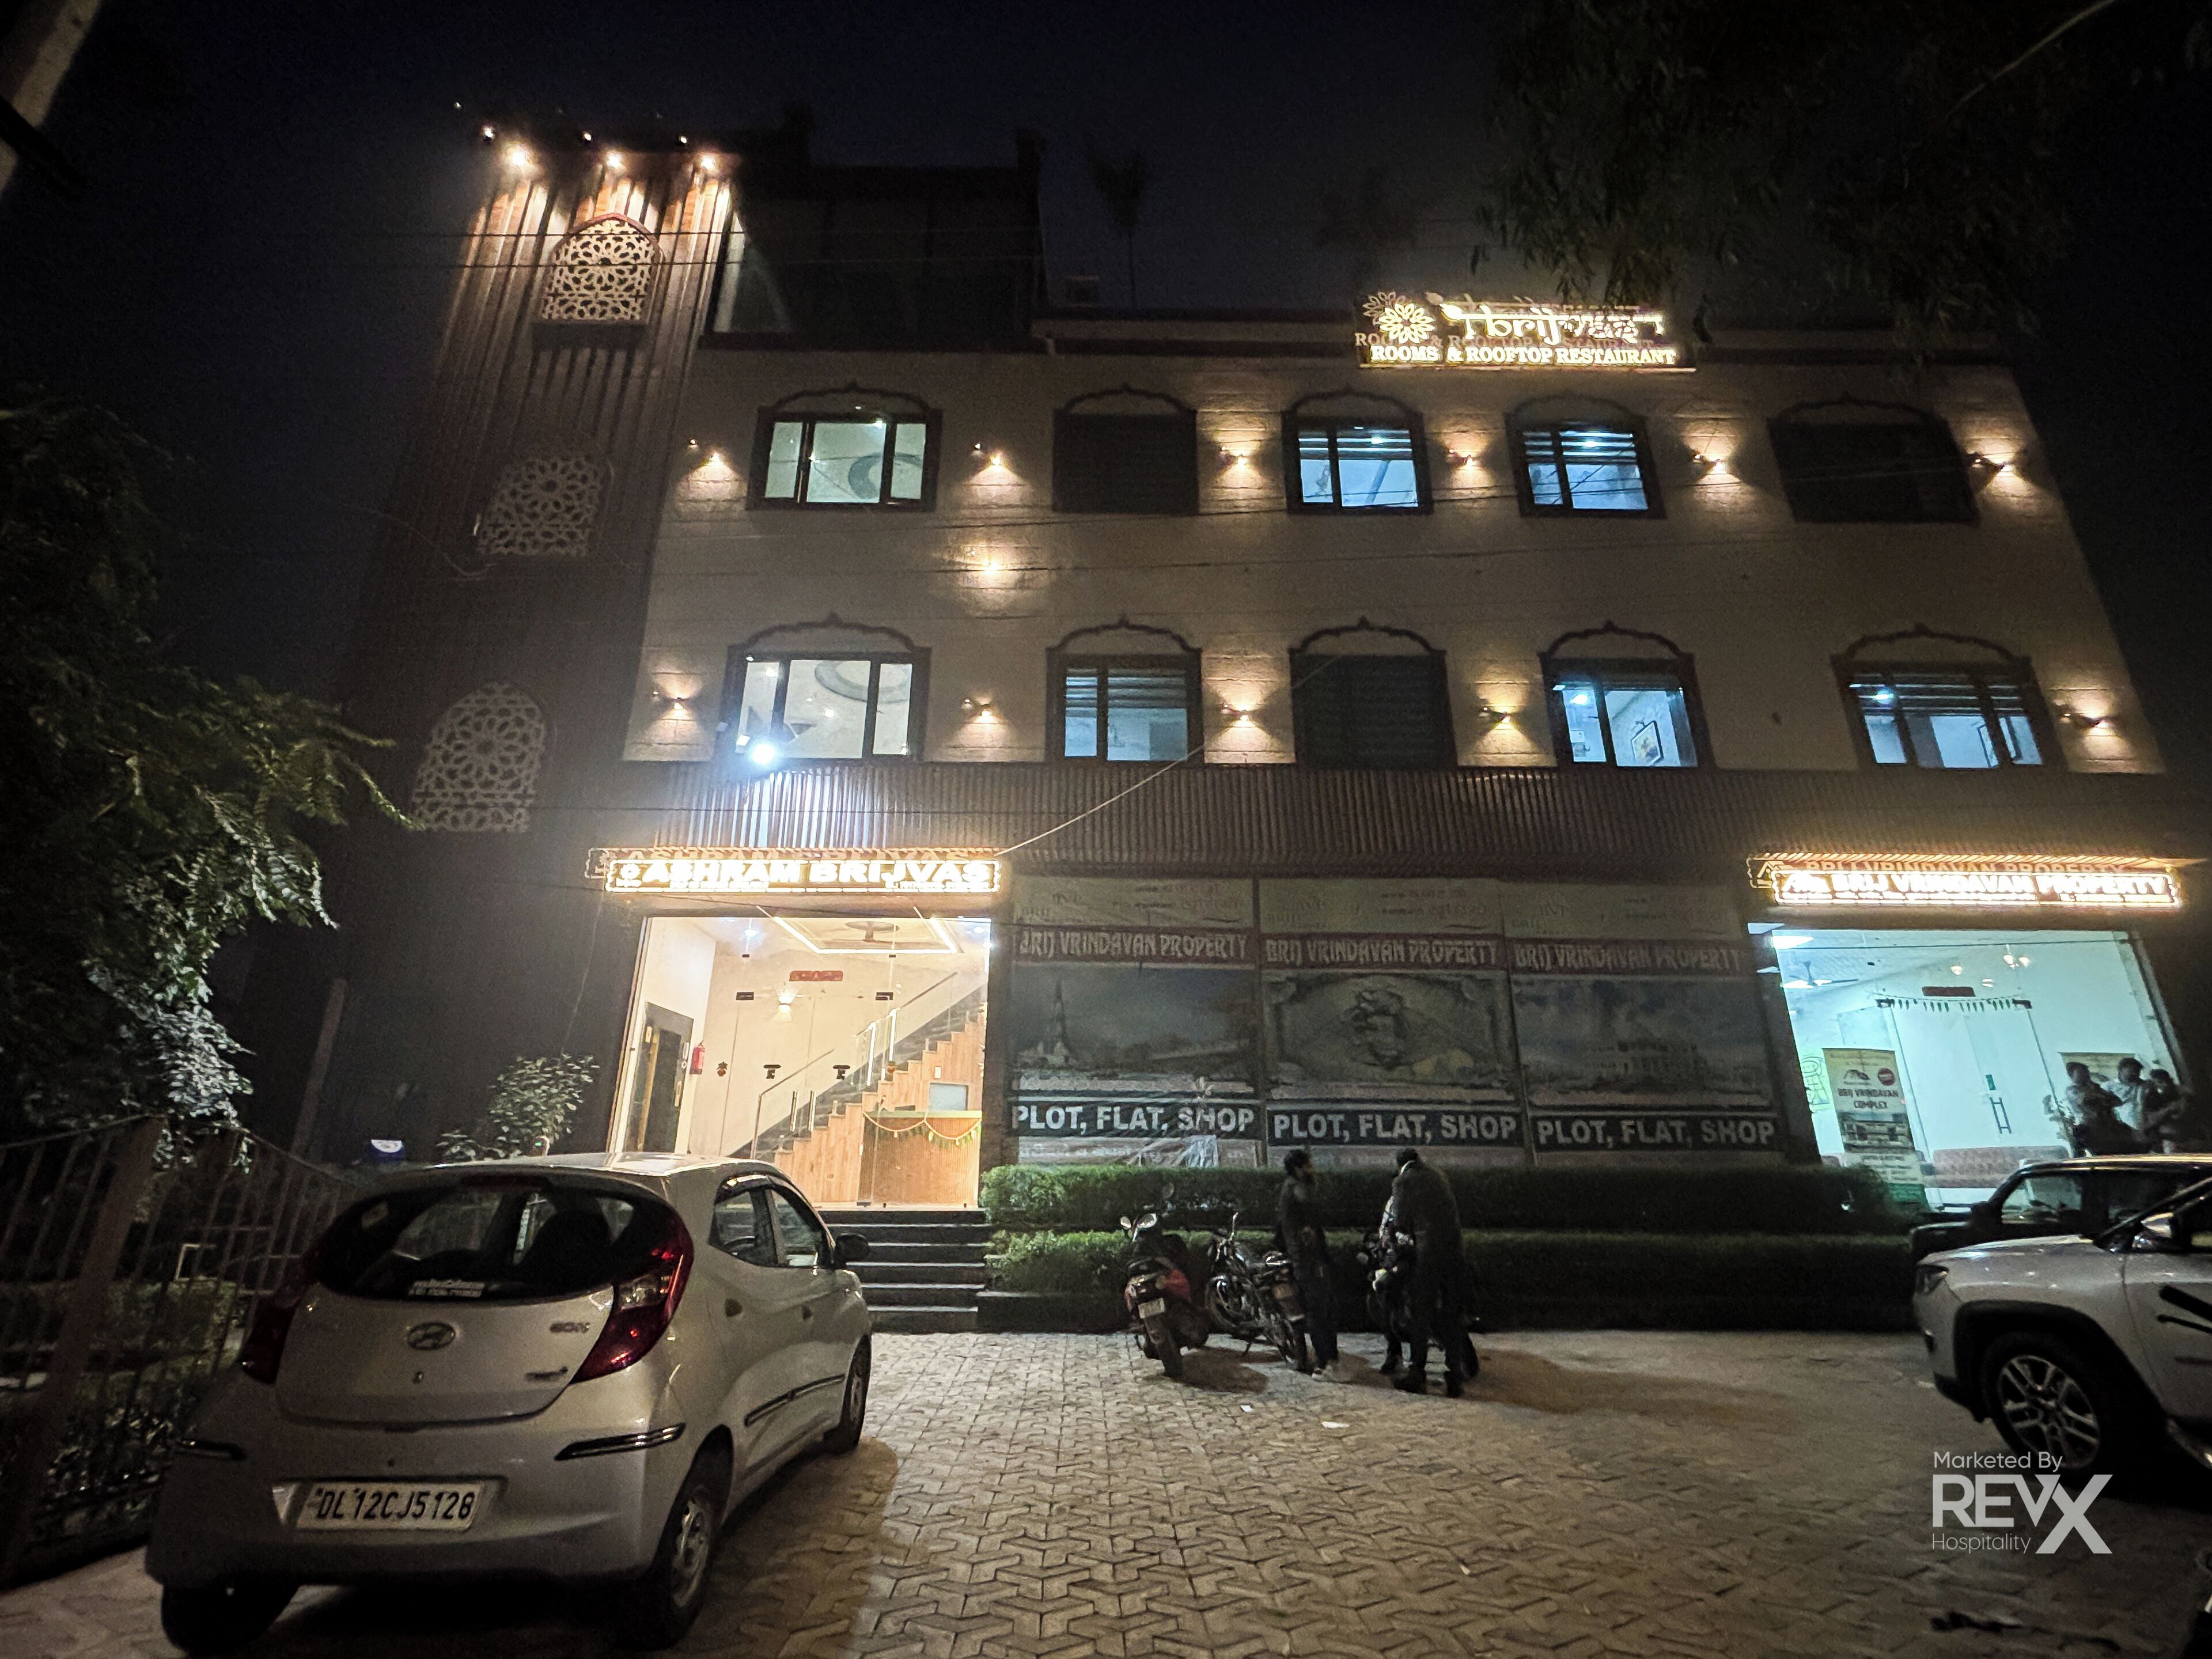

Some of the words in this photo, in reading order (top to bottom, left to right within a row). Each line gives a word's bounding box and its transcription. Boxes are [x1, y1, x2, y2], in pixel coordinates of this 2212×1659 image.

[1370, 345, 1439, 362] ROOMS
[1446, 346, 1464, 362] &
[1465, 347, 1552, 363] ROOFTOP
[1555, 348, 1677, 365] RESTAURANT
[642, 863, 800, 882] ASHRAM
[809, 863, 988, 882] BRIJVAS
[1059, 932, 1158, 957] VRINDAVAN
[1160, 933, 1249, 960] PROPERTY
[1307, 940, 1406, 964] VRINDAVAN
[1408, 940, 1497, 965] PROPERTY
[1012, 1105, 1087, 1135] PLOT,
[1096, 1106, 1169, 1135] FLAT,
[1178, 1107, 1255, 1132] SHOP
[1274, 1113, 1350, 1143] PLOT,
[1358, 1114, 1431, 1144] FLAT,
[1440, 1114, 1517, 1140] SHOP
[1536, 1119, 1614, 1149] PLOT,
[1619, 1120, 1693, 1149] FLAT,
[1700, 1120, 1775, 1145] SHOP
